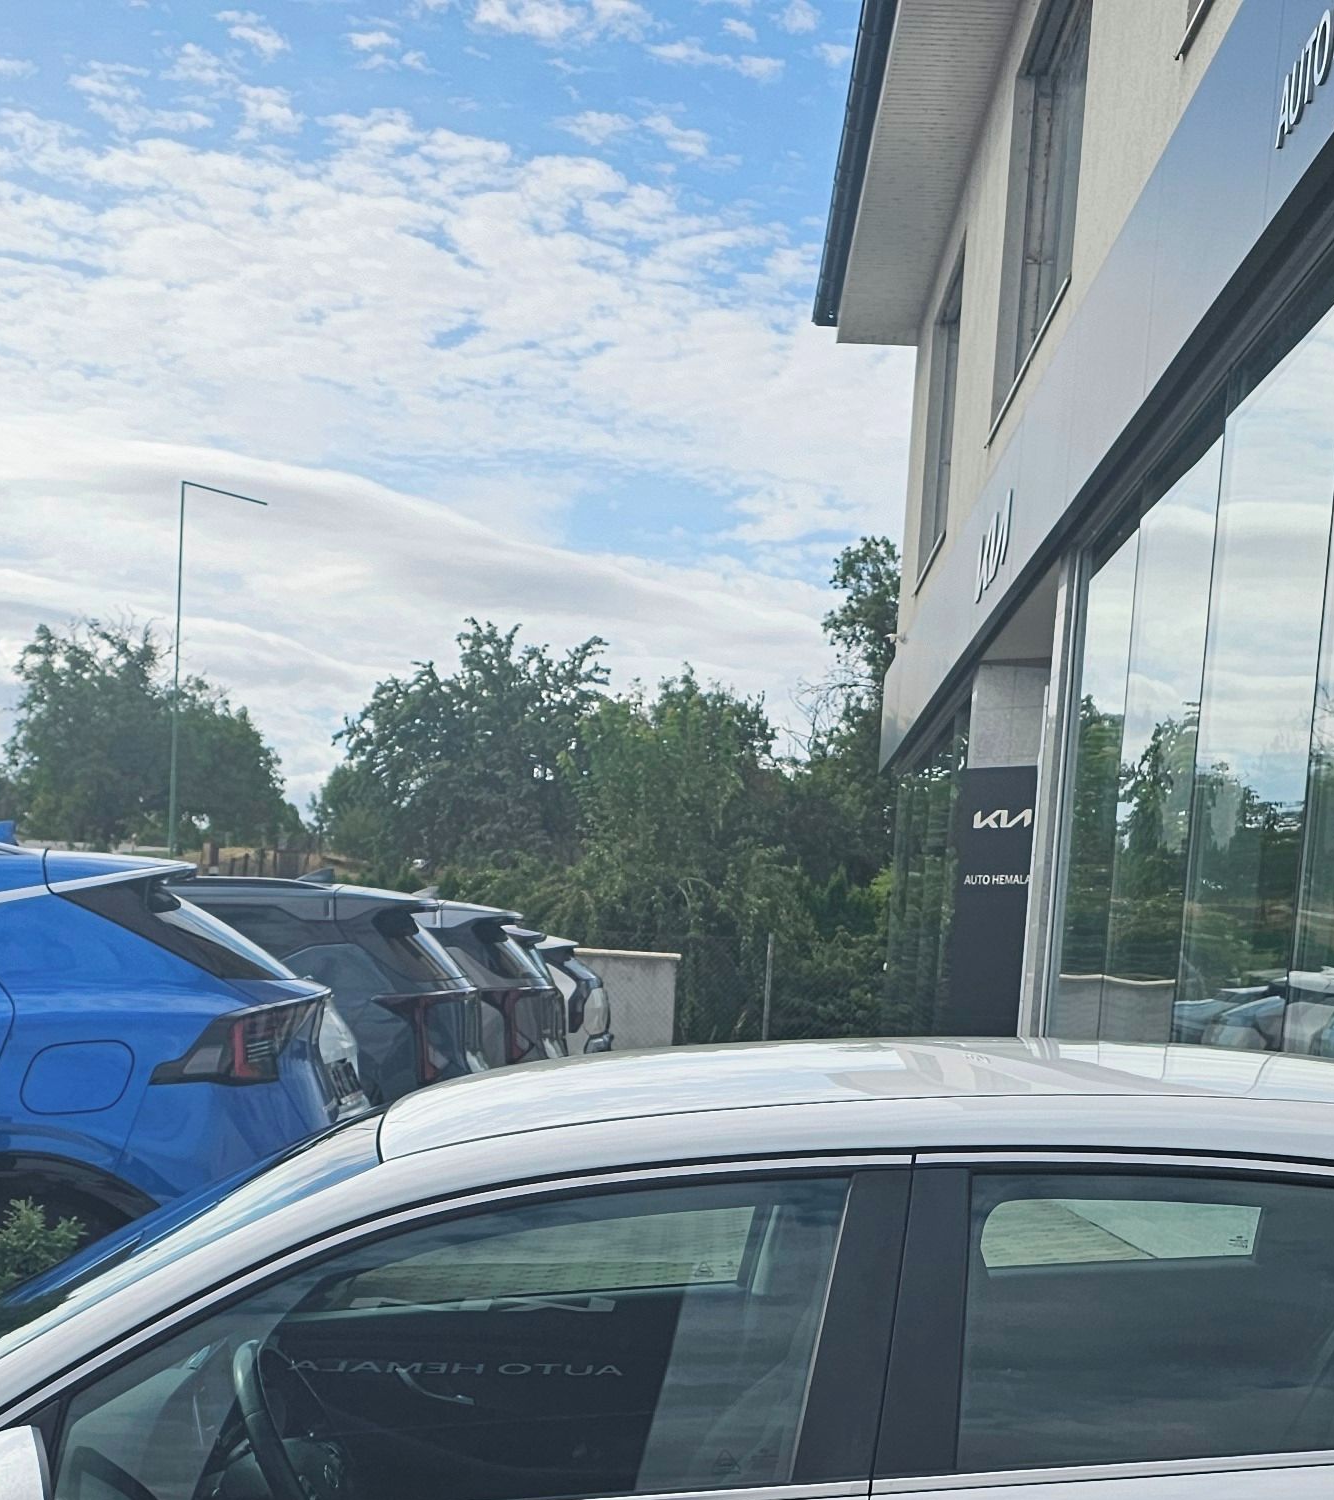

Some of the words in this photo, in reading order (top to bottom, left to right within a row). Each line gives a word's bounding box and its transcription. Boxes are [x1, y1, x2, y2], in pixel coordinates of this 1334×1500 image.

[1275, 9, 1331, 149] AUTO
[973, 808, 1032, 828] KIA
[964, 874, 990, 885] AUTO
[992, 874, 1031, 885] HEMALA
